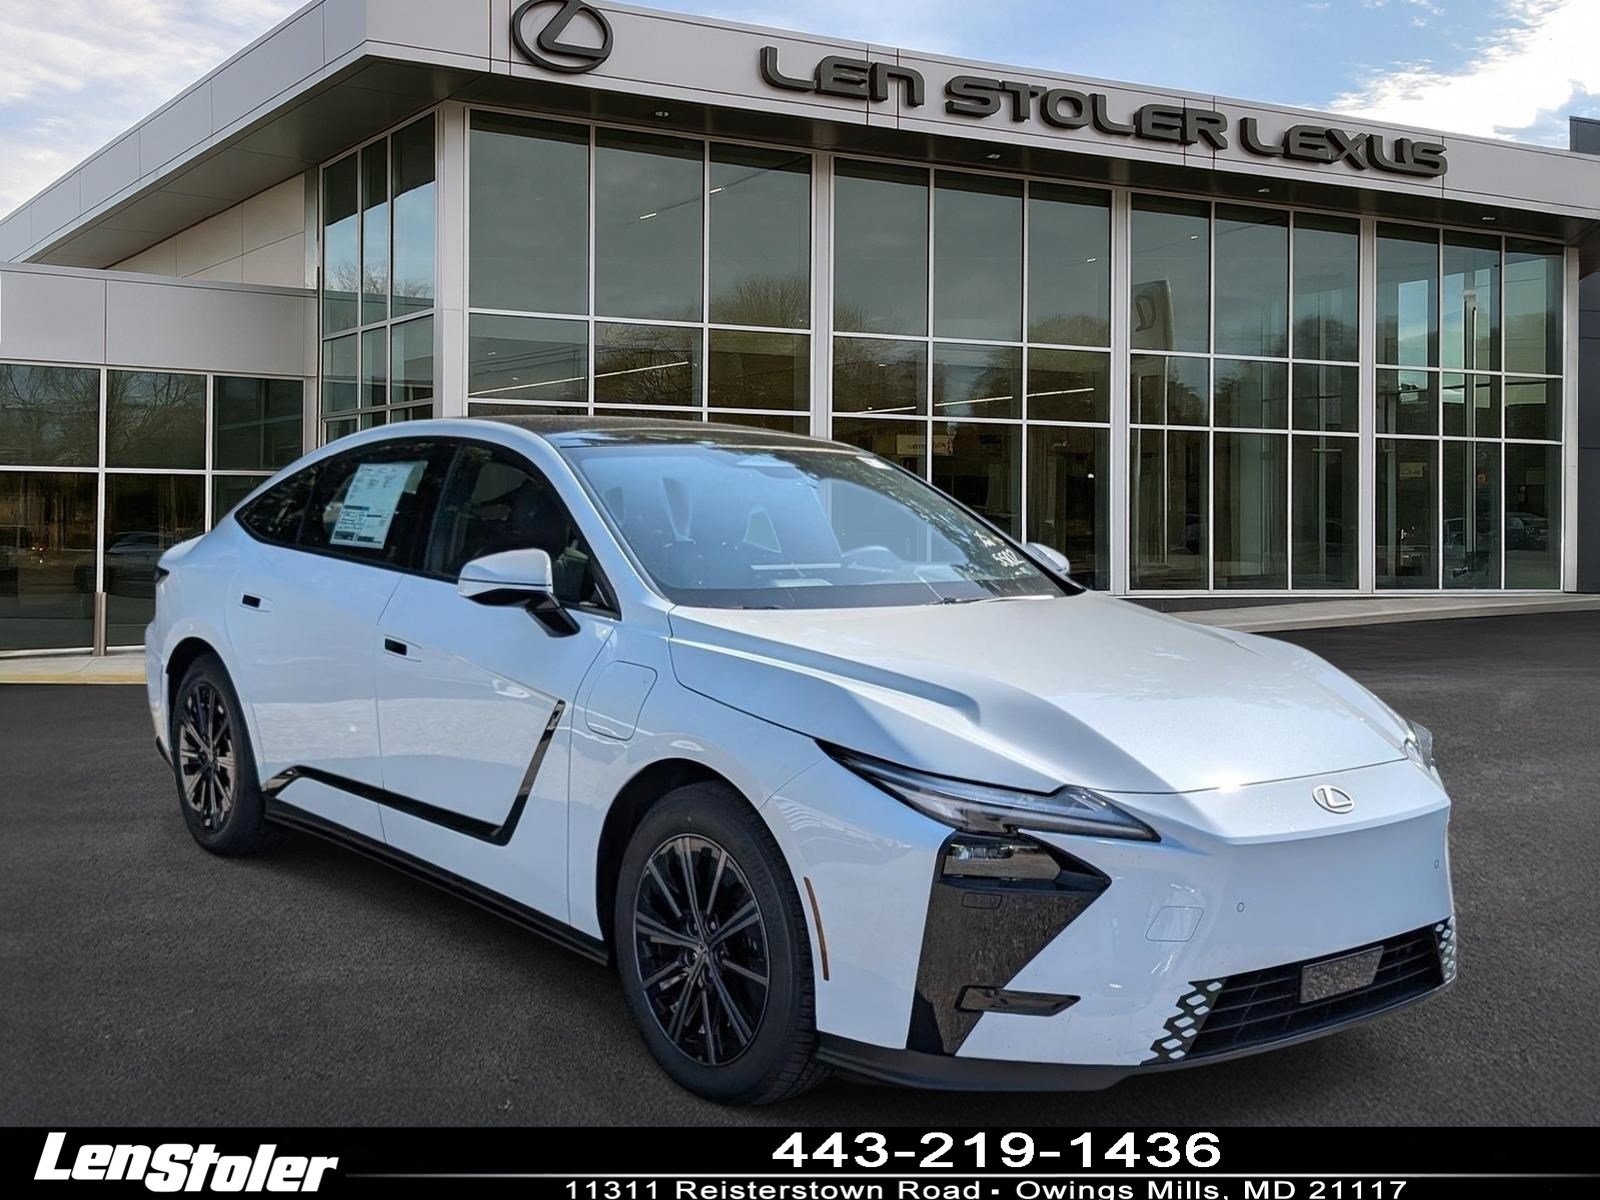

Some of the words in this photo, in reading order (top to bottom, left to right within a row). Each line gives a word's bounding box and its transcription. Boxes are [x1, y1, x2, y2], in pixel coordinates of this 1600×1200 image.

[760, 46, 924, 106] LEN
[945, 75, 1228, 150] STOLER
[1240, 117, 1449, 178] LEXUS
